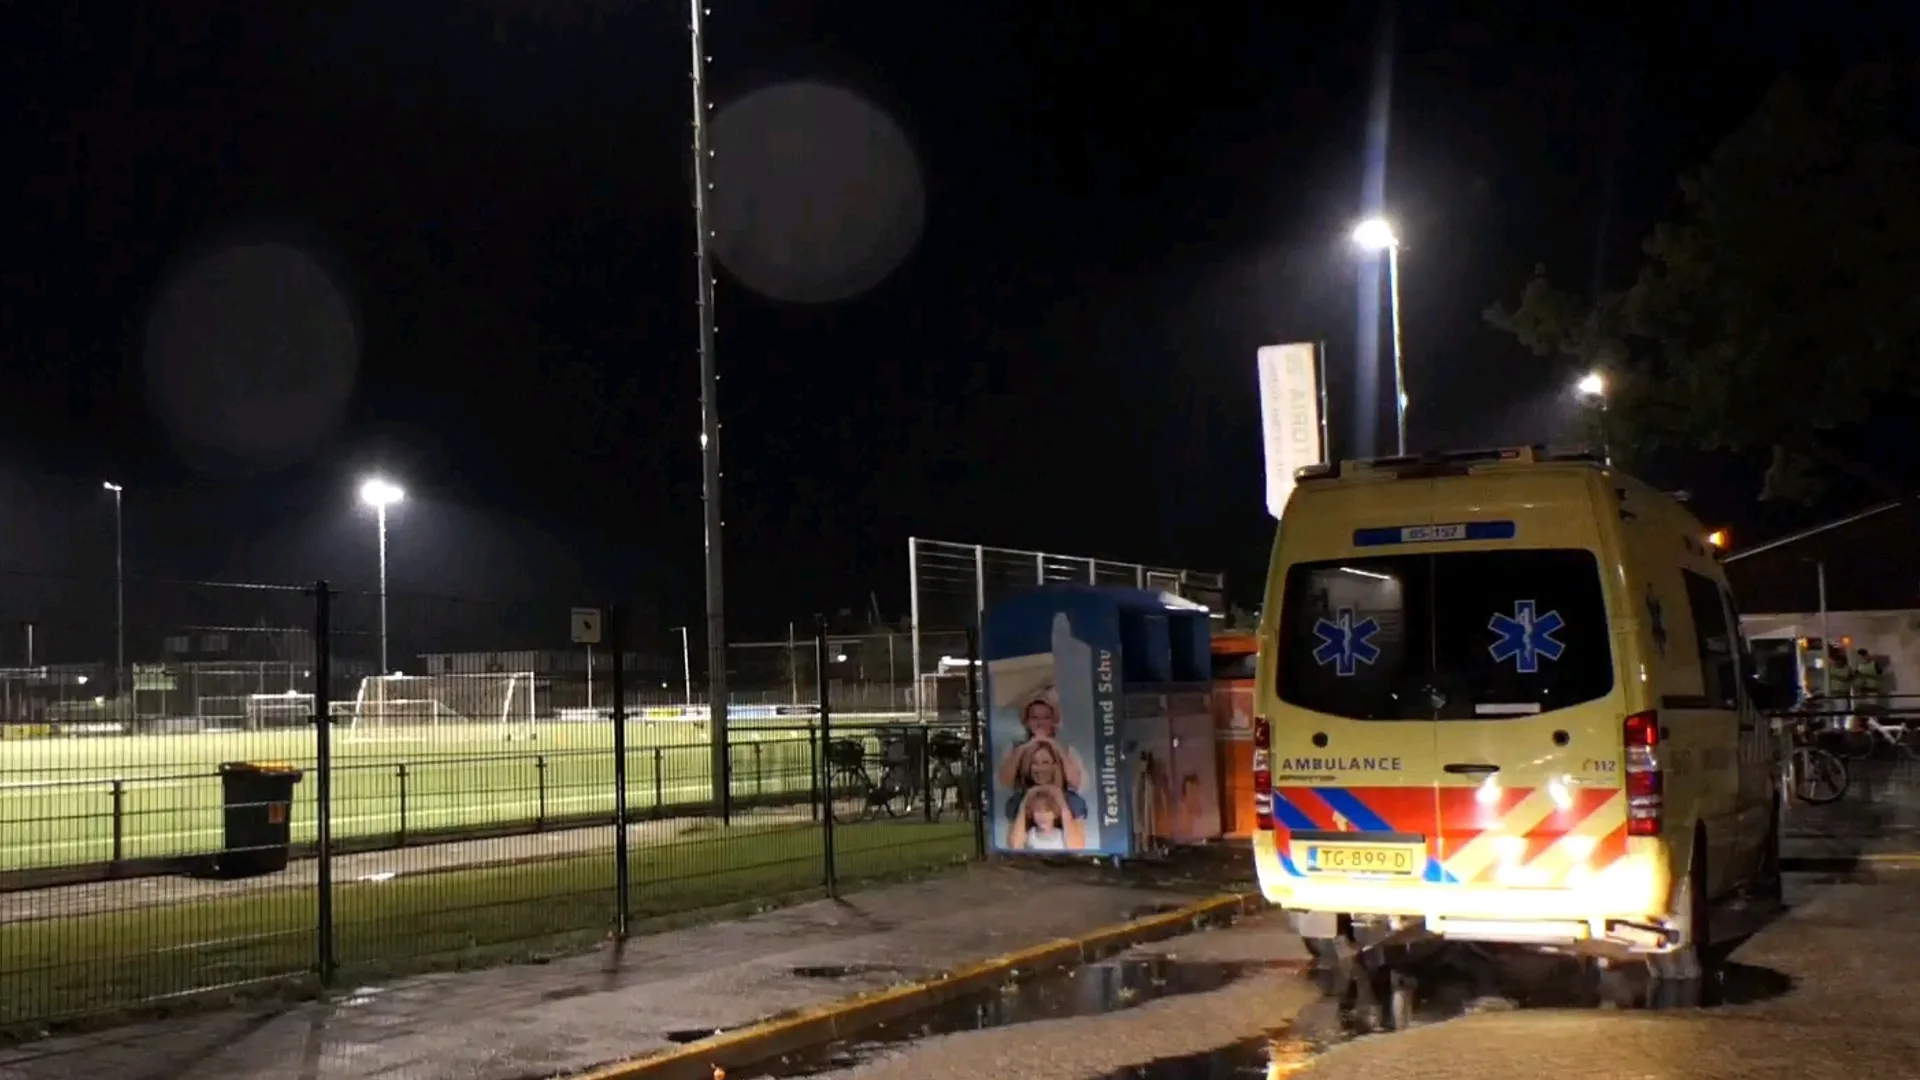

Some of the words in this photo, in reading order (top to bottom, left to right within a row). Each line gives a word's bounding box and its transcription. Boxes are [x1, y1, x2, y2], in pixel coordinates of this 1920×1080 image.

[1100, 700, 1114, 737] und
[1282, 757, 1402, 771] AMBULANCE
[1594, 760, 1616, 772] 112
[1102, 744, 1119, 827] Textilien
